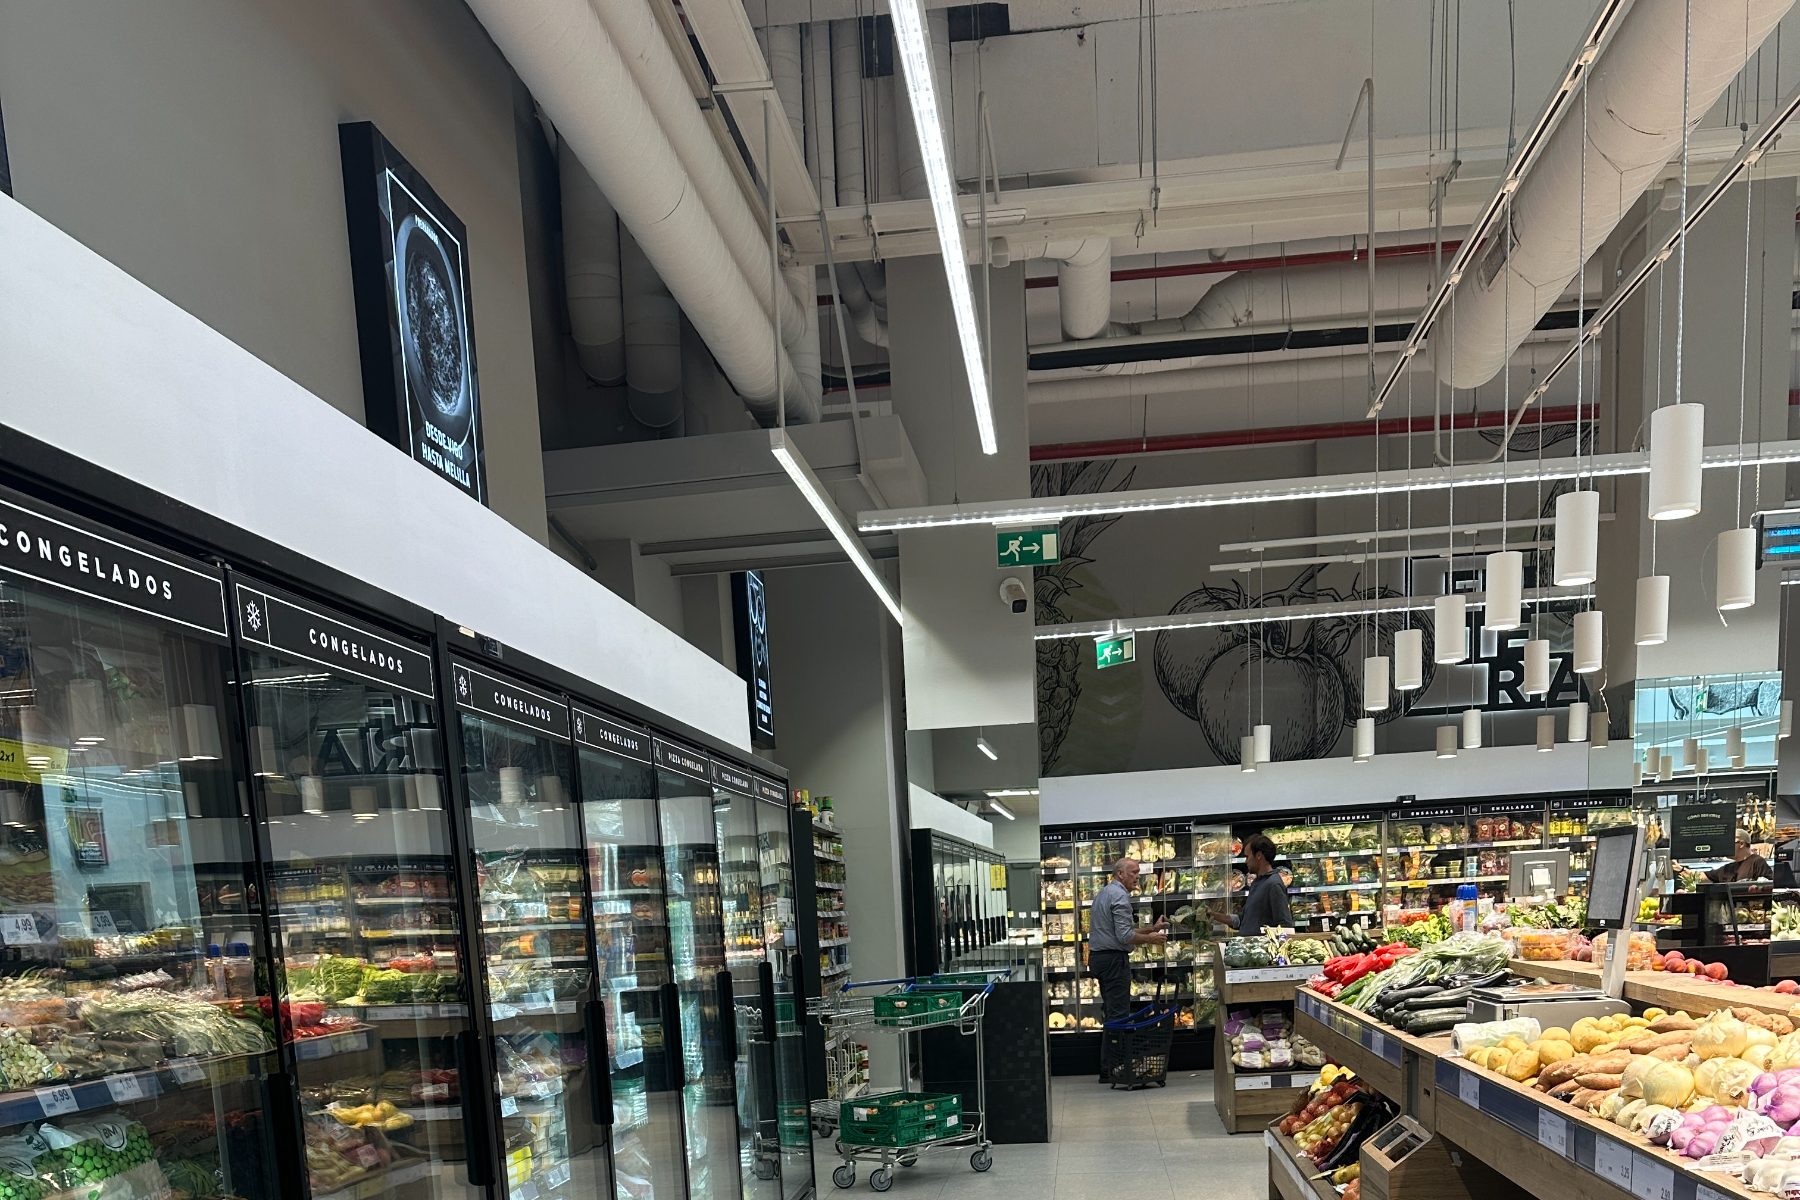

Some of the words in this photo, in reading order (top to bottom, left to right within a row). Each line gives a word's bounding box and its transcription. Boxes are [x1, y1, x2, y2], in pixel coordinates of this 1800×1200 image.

[425, 420, 447, 449] DESDE
[421, 442, 444, 471] HASTA
[0, 524, 173, 600] CONGELADOS
[309, 628, 403, 674] CONGELADOS
[1488, 655, 1590, 705] RA
[494, 691, 552, 723] CONGELADOS
[599, 728, 639, 752] CONGELADOS
[1491, 804, 1535, 812] ENSALADAS
[102, 1124, 118, 1139] BM
